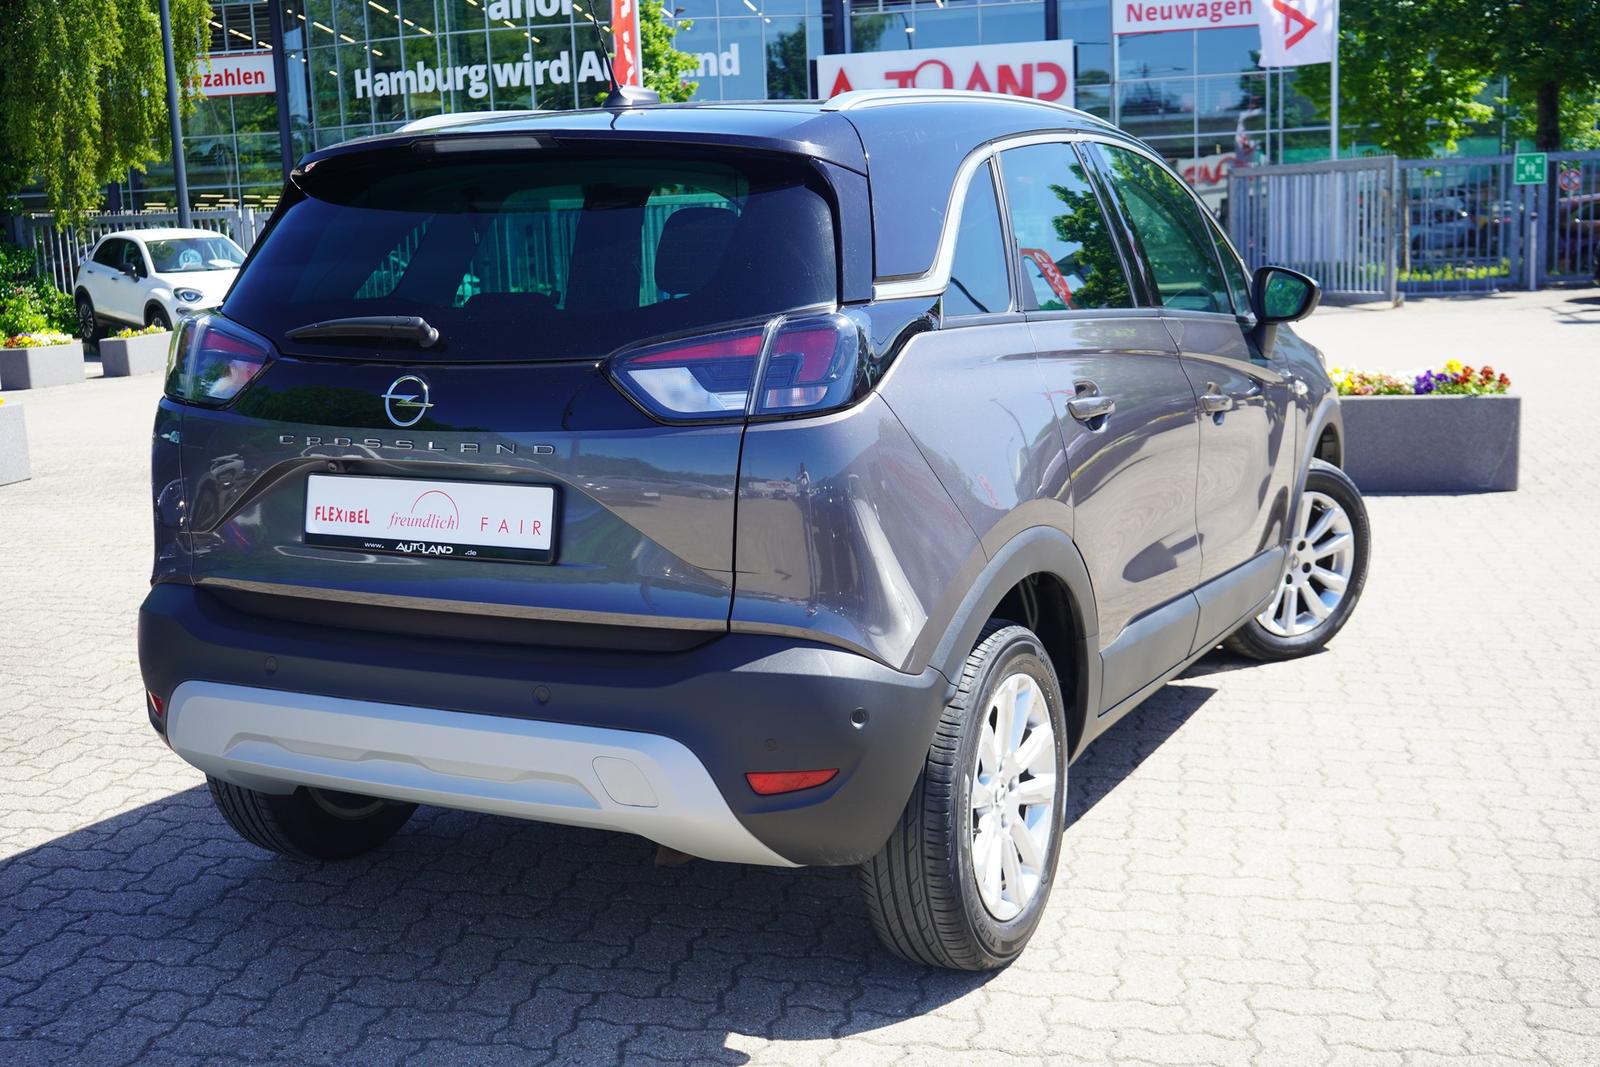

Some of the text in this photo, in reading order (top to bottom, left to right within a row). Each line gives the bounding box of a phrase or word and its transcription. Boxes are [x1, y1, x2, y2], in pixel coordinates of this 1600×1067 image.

[1126, 0, 1253, 23] Neuwagen
[192, 67, 265, 88] zahlen
[354, 61, 489, 99] Hamburg
[493, 51, 571, 88] wird
[830, 59, 1067, 102] ATOAND
[279, 435, 554, 456] CROSSLAND
[314, 505, 542, 536] FLEXIBEL freundlich FAIR
[396, 542, 453, 556] AUTOLAND
